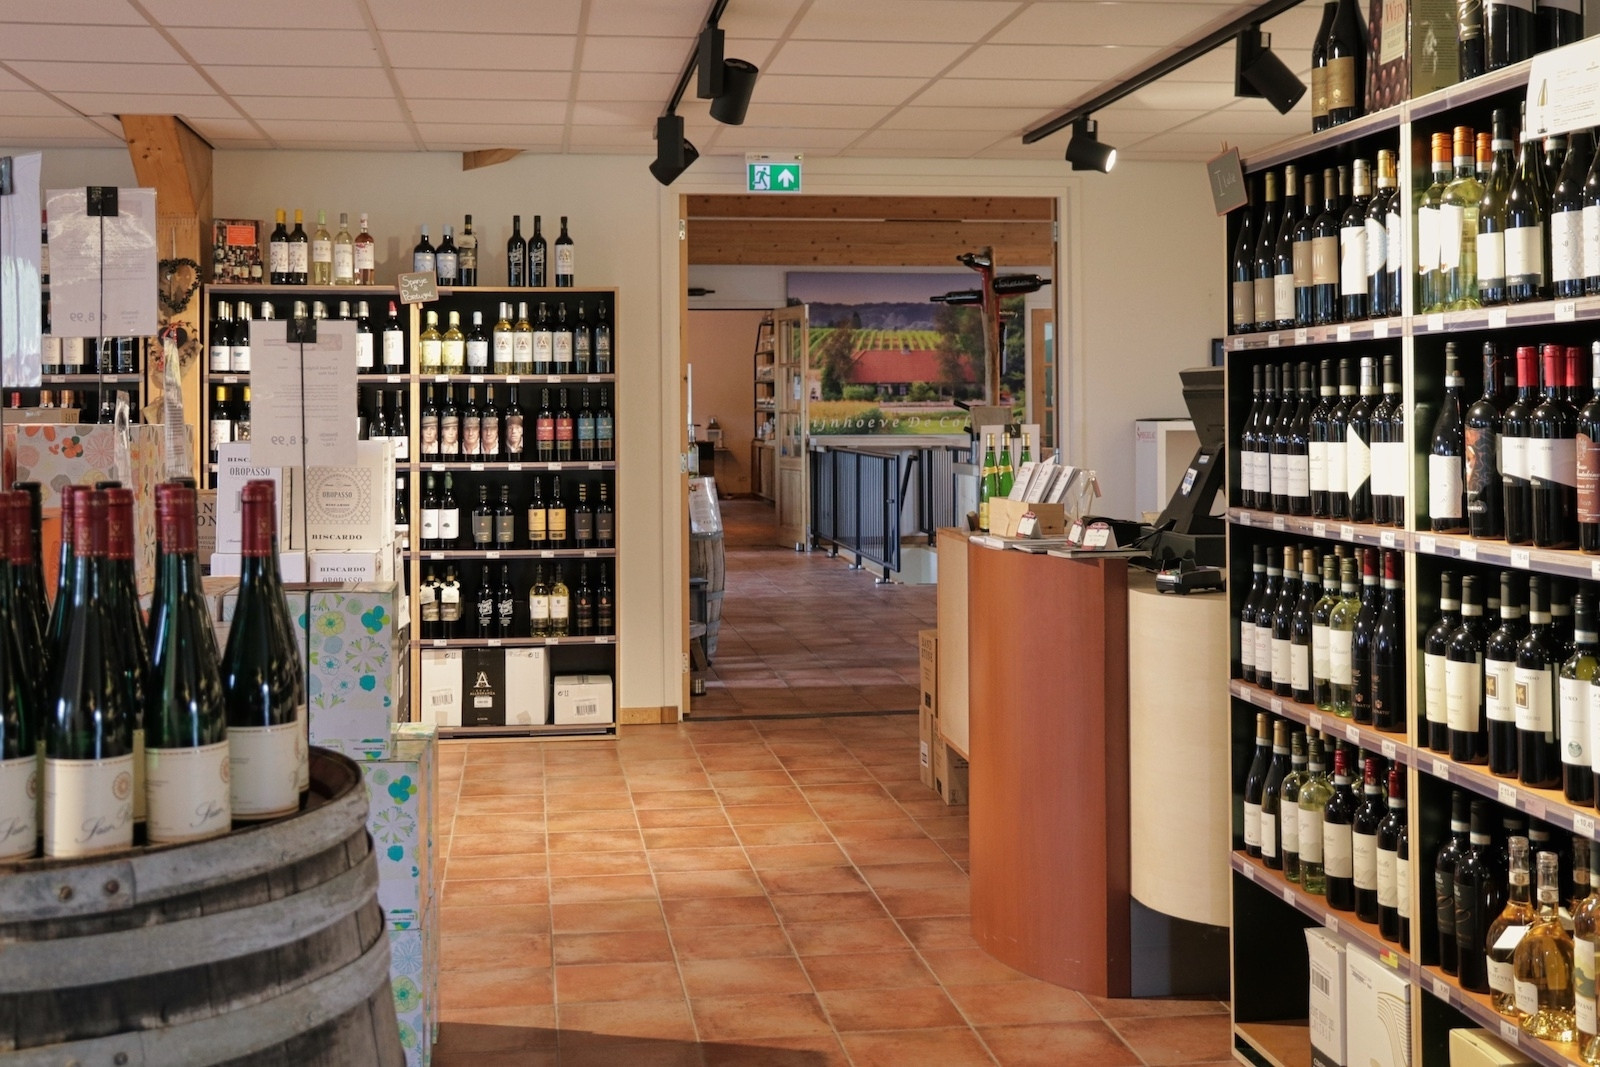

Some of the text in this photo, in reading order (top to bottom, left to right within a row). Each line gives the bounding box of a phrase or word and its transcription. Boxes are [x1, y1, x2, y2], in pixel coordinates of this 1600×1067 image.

[796, 415, 900, 432] ijnhoeve
[907, 416, 932, 428] De
[229, 467, 271, 477] OROPASSO
[322, 490, 353, 498] OROPASSO
